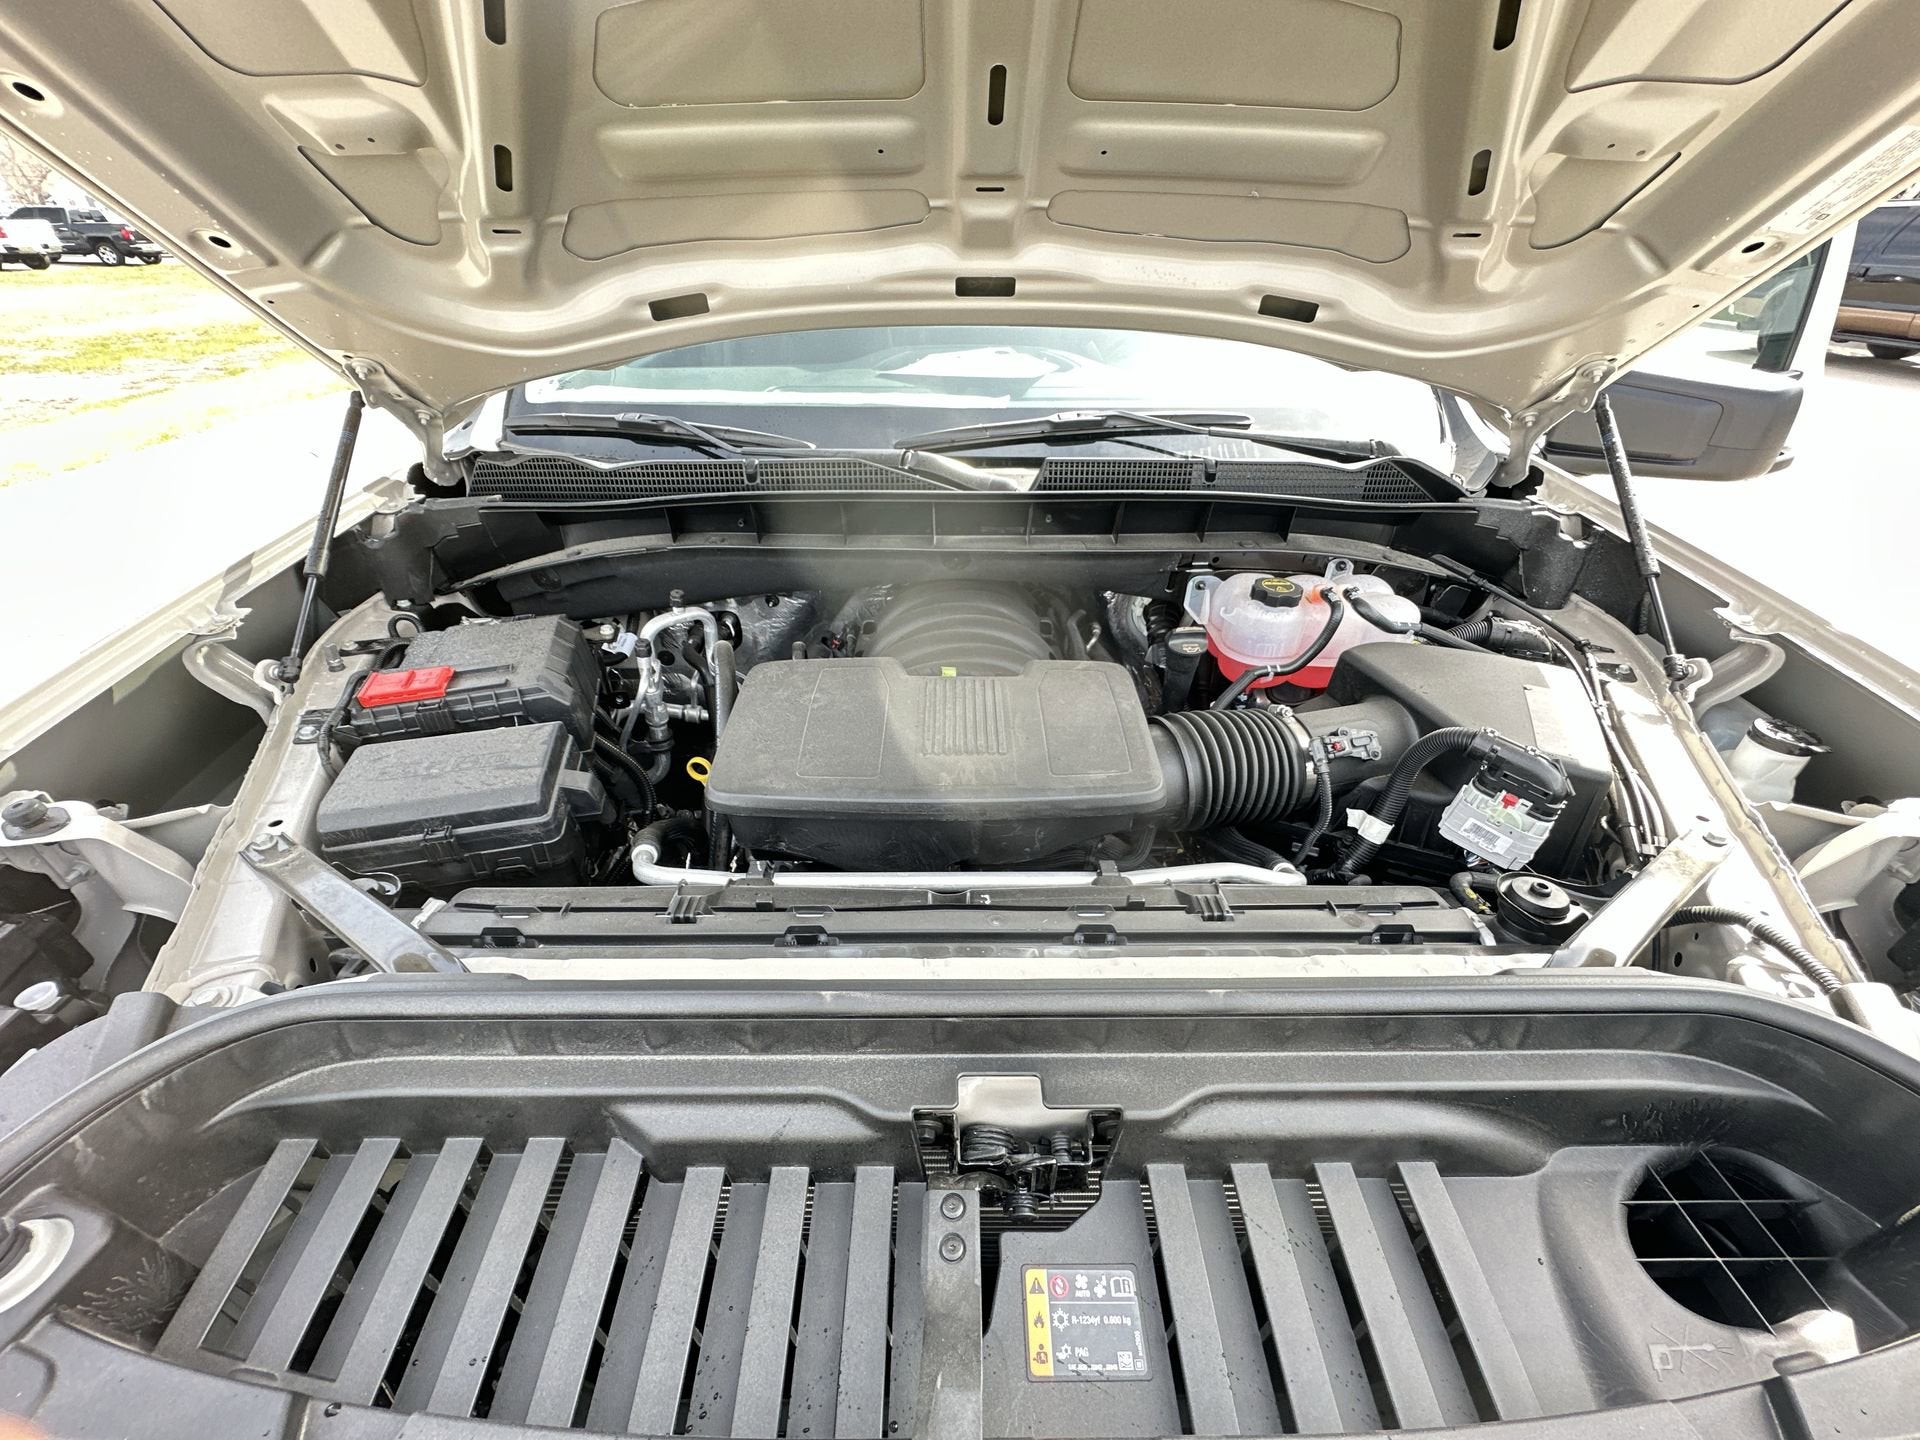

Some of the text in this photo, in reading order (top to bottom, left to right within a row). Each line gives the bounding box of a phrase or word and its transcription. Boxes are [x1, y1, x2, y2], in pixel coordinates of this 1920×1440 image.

[1075, 1290, 1090, 1298] AUTO
[1122, 1315, 1131, 1326] kg
[1075, 1347, 1089, 1357] PAG
